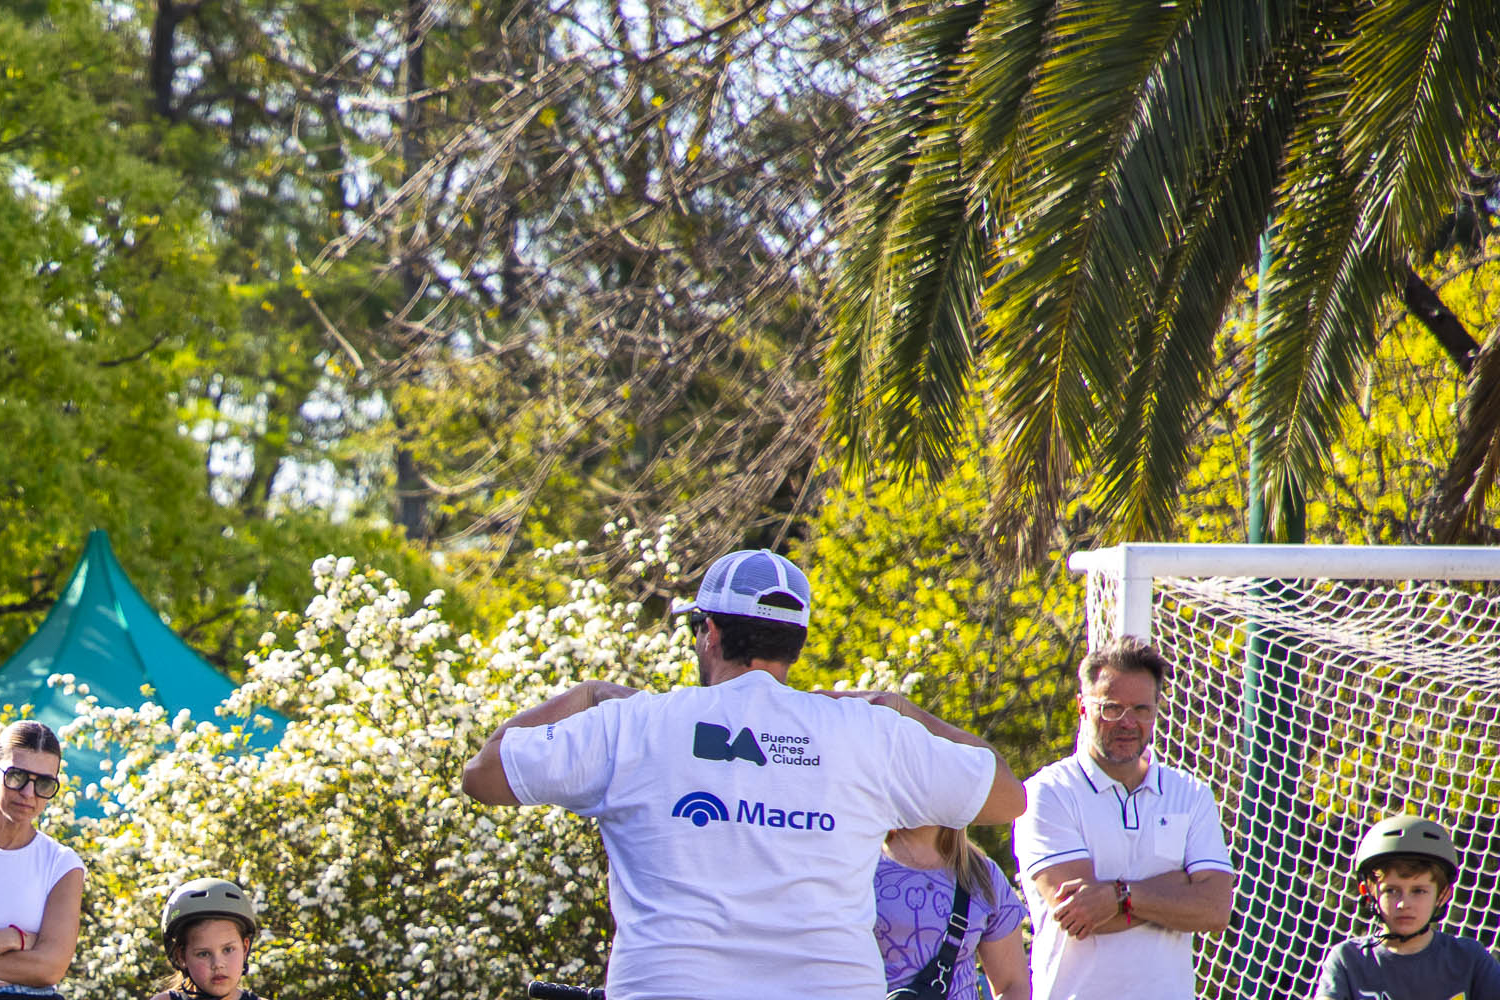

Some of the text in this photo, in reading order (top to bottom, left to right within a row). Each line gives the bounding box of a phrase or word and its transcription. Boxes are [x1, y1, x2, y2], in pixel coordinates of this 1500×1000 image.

[761, 733, 810, 745] Buenos
[768, 744, 805, 755] Aires
[772, 754, 820, 766] Ciudad
[736, 799, 835, 831] Macro
